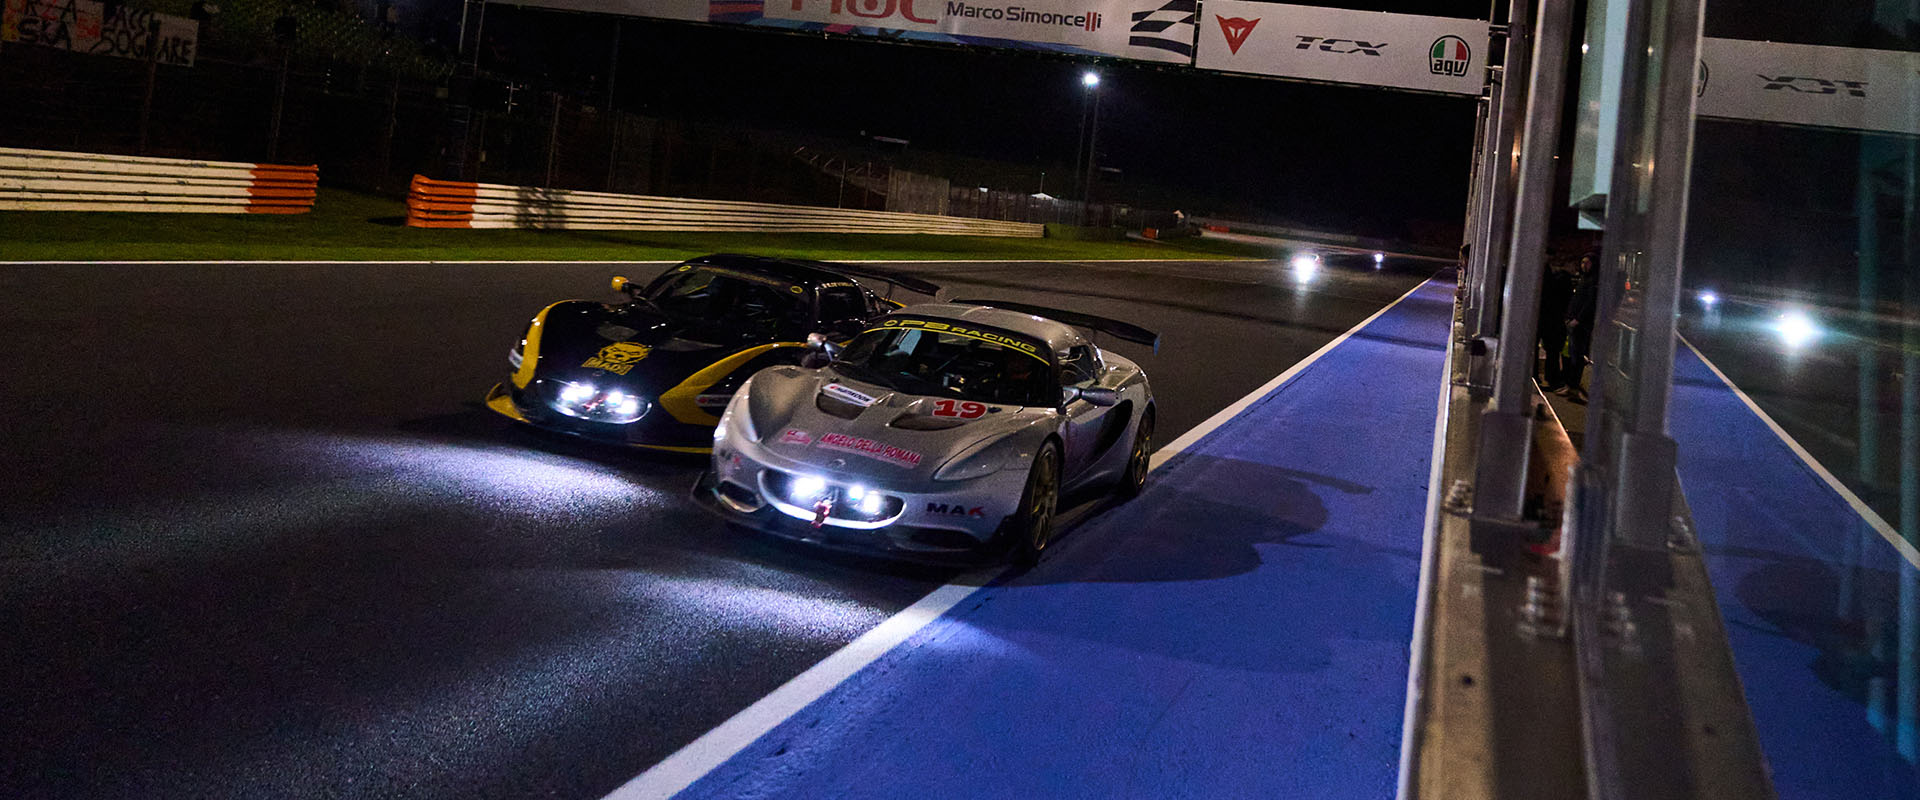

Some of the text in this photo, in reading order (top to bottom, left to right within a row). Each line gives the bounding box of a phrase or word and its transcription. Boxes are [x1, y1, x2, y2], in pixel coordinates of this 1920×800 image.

[947, 1, 1102, 32] Marco Simoncelli
[1296, 35, 1388, 56] TCX
[1434, 59, 1466, 76] agv
[951, 326, 1037, 353] RACING
[933, 400, 986, 418] 19
[820, 432, 856, 447] ANGELO
[855, 438, 883, 453] DELLA
[883, 444, 922, 465] ROMANA
[927, 503, 984, 516] MAK
